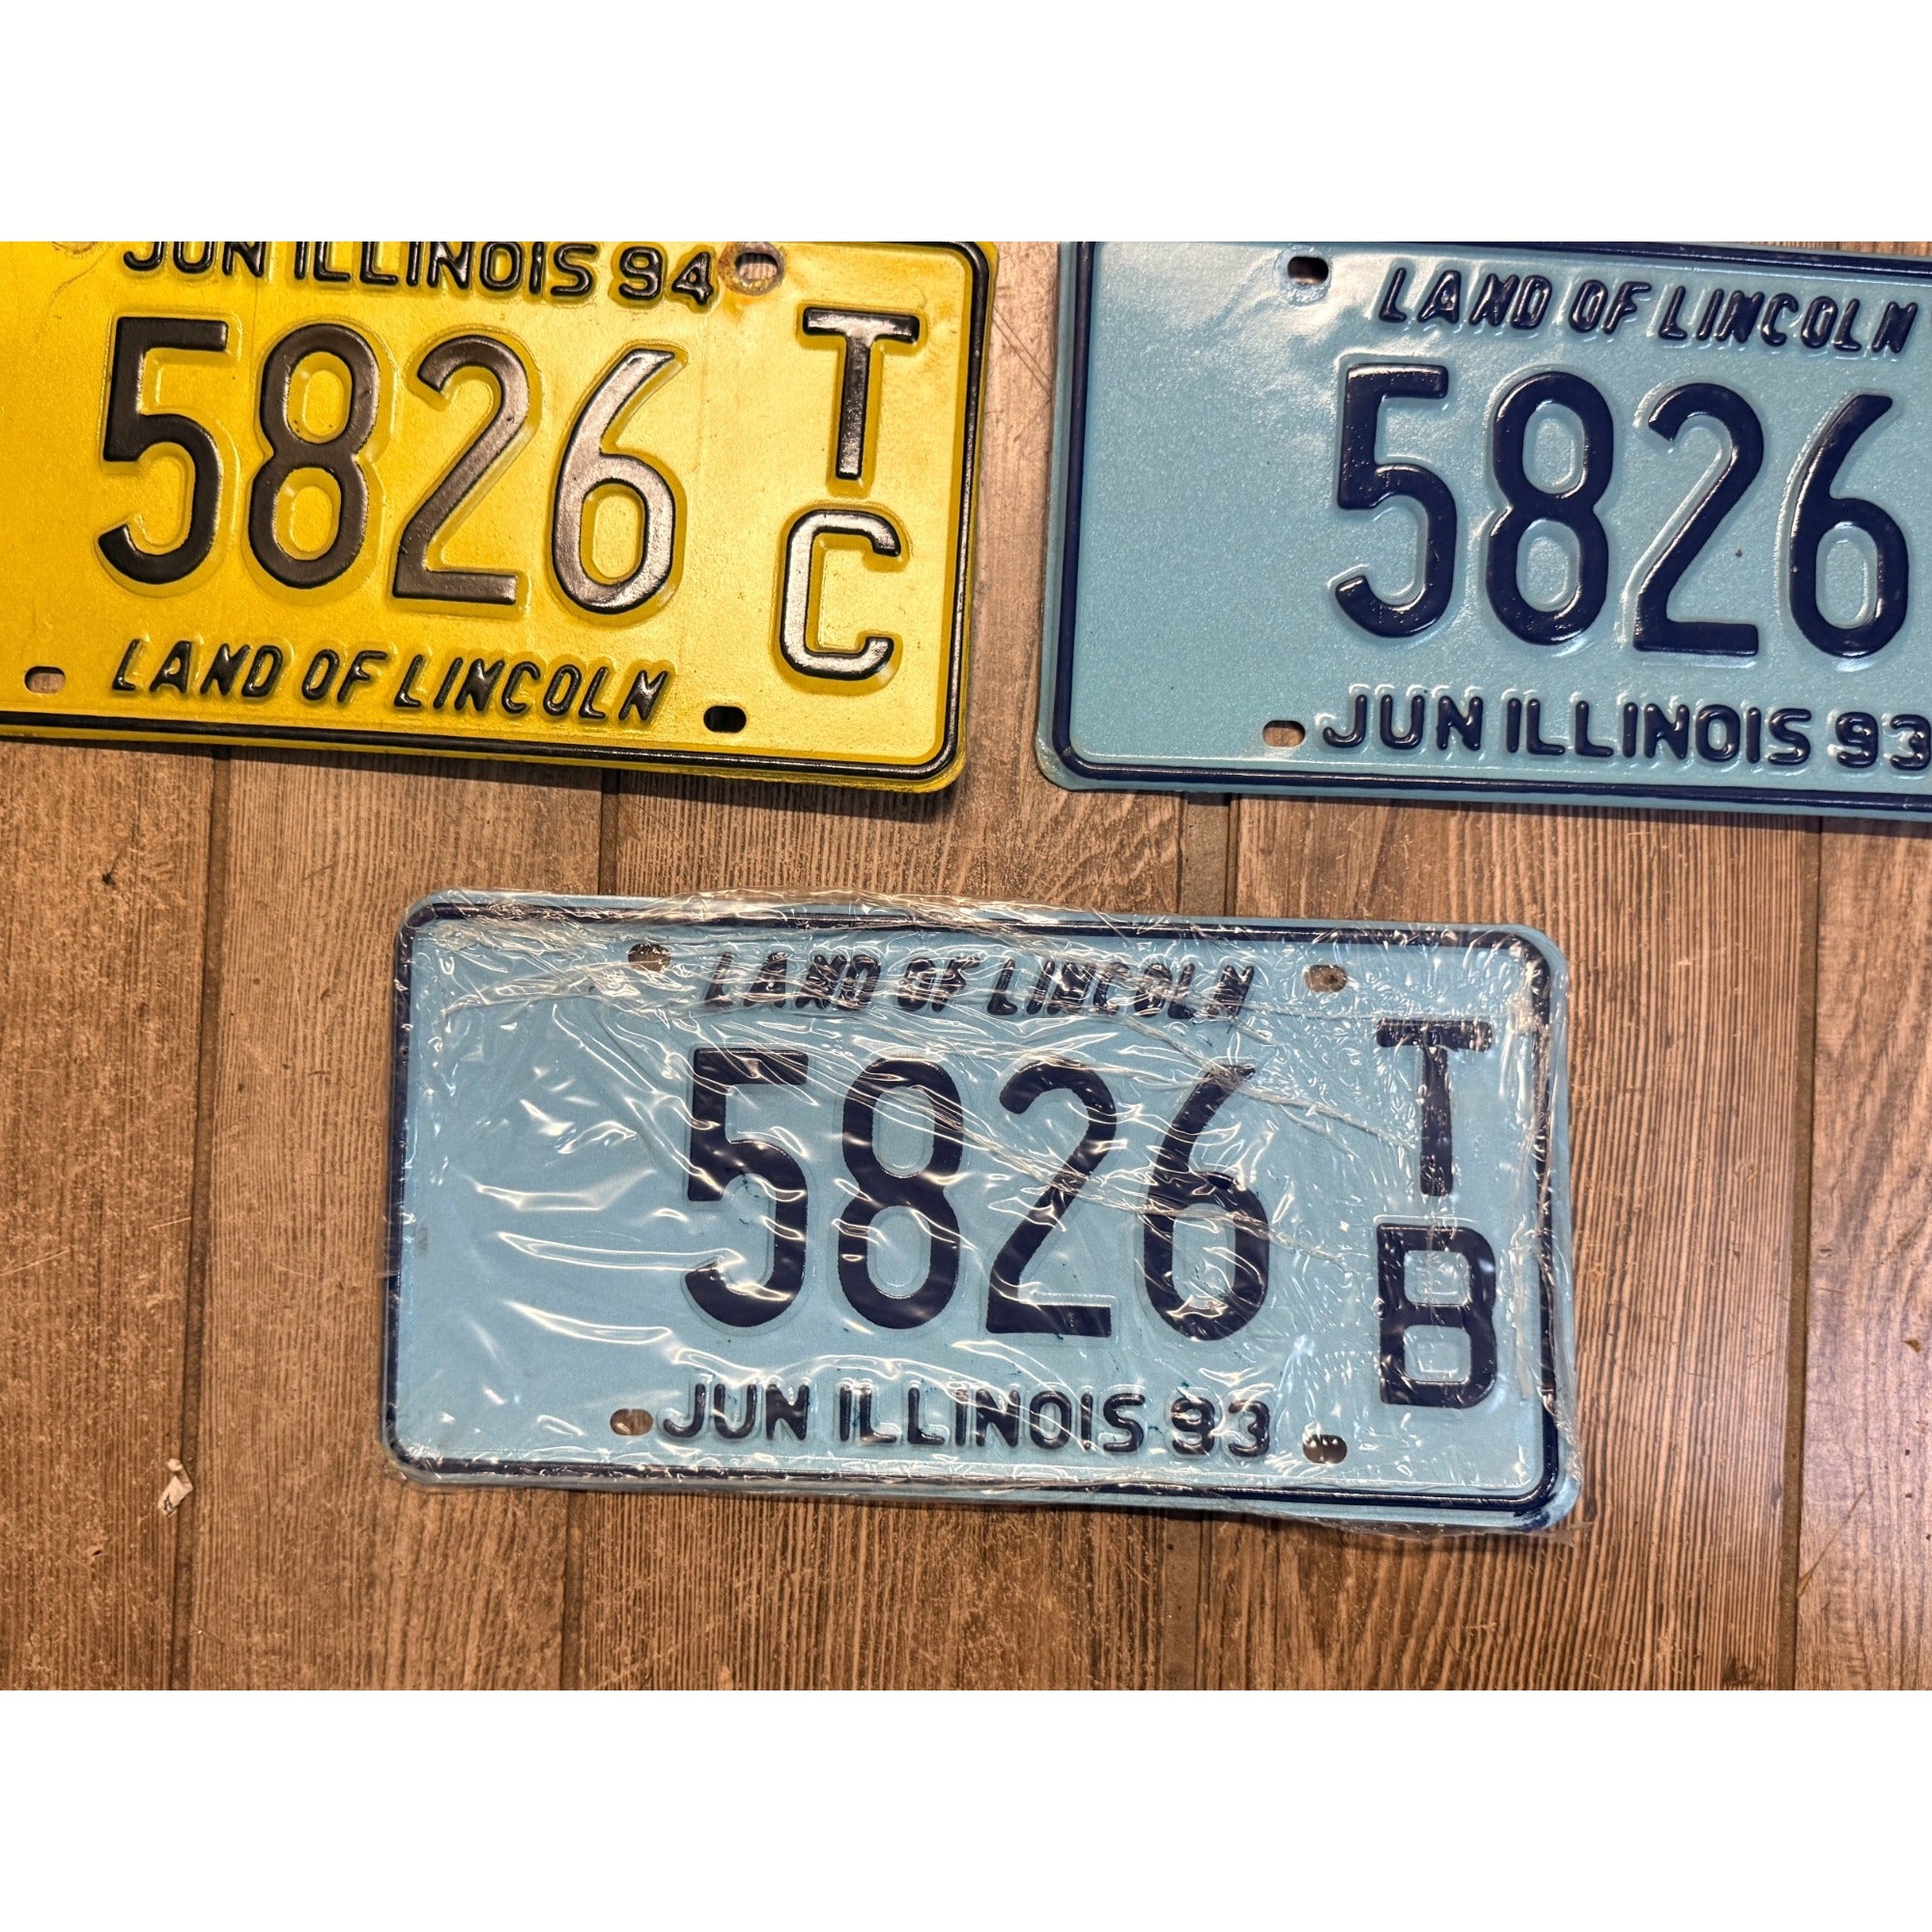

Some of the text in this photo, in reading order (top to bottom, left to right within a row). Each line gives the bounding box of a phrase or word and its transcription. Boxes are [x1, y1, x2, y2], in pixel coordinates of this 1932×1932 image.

[122, 242, 713, 305] JUN ILLINOIS 94
[1378, 267, 1918, 355] LAND OF LINCOLN
[99, 316, 677, 612] 5826
[1334, 363, 1909, 659] 5826
[111, 638, 674, 724] LAND OF LINCOLN
[1321, 693, 1932, 772] JUN ILLINOIS 93
[703, 950, 1257, 1020] LAND OF LINCOLN
[683, 1046, 1270, 1343] 5826
[663, 1381, 1270, 1458] JUN ILLINOIS 93
